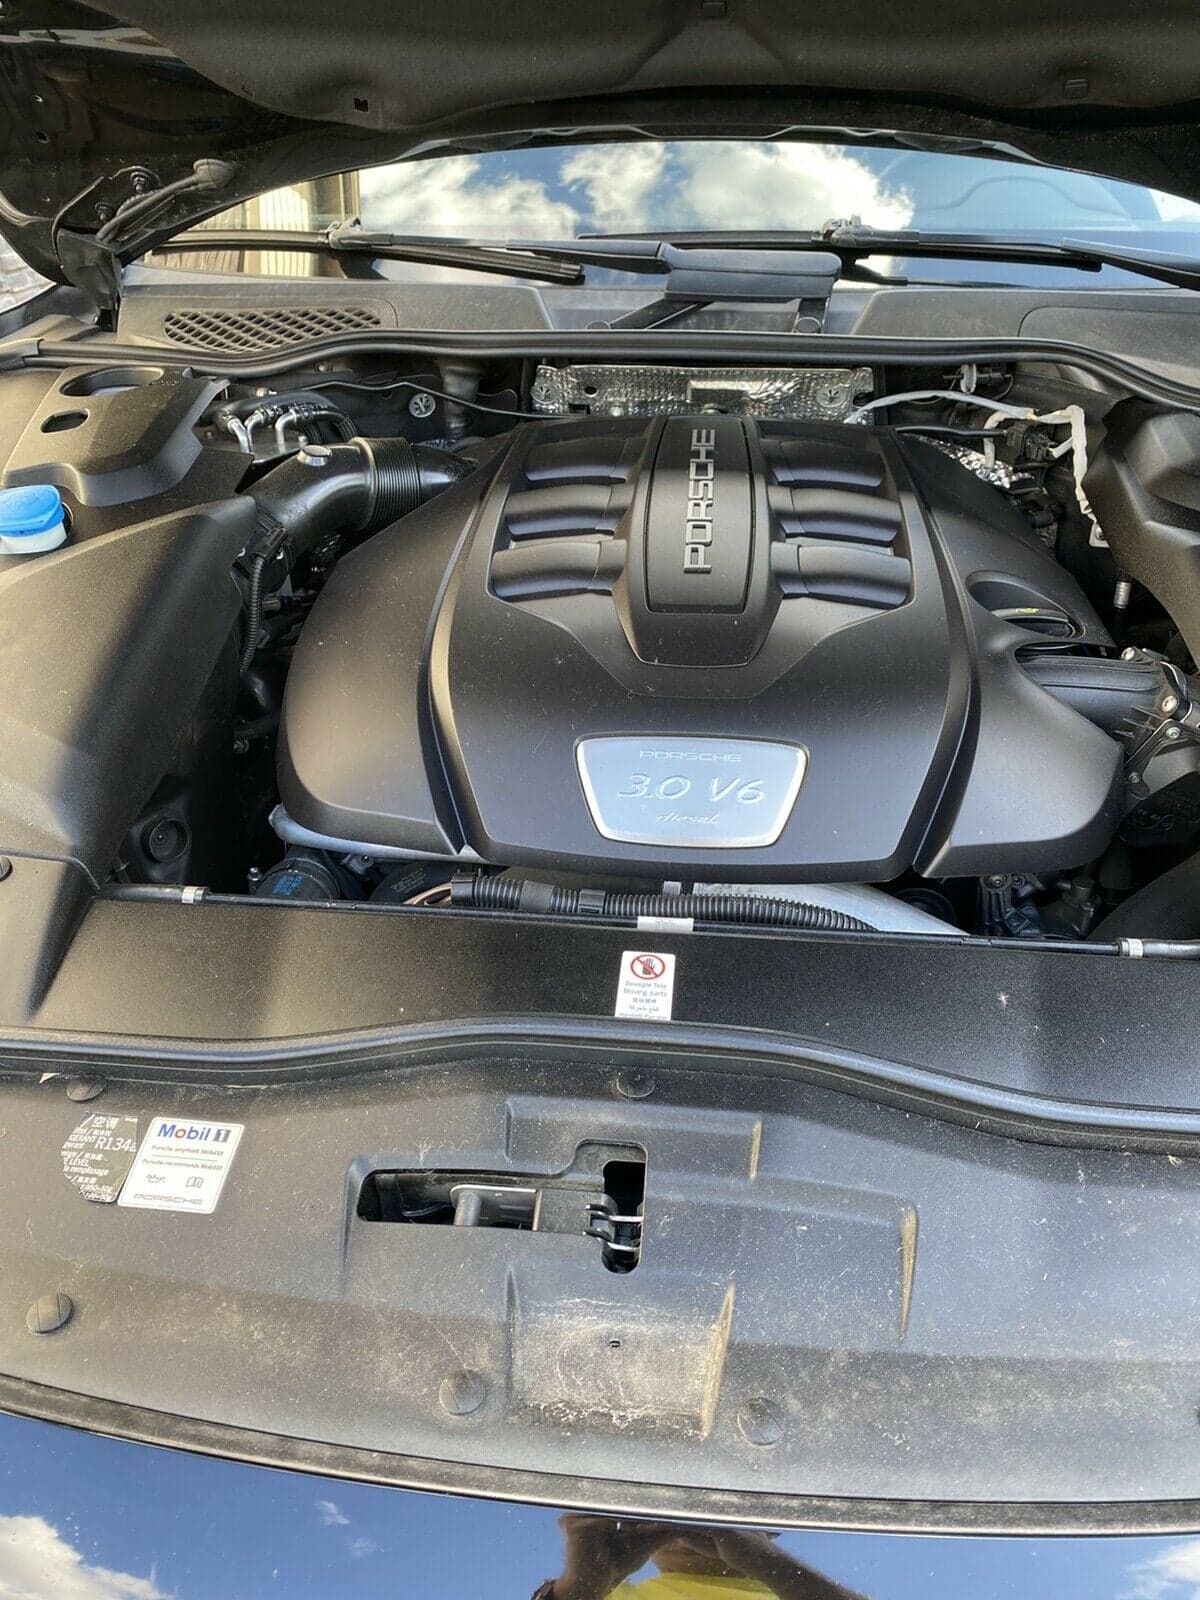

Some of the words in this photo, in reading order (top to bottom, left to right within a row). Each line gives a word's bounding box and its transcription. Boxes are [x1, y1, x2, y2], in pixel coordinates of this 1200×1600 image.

[684, 429, 715, 574] PORSCHE
[639, 751, 743, 762] PORSCHE
[616, 774, 691, 800] 3.0
[711, 777, 765, 804] V6
[656, 811, 720, 825] diesel
[158, 1124, 211, 1141] Mobil
[133, 1193, 203, 1205] PORSCHE
